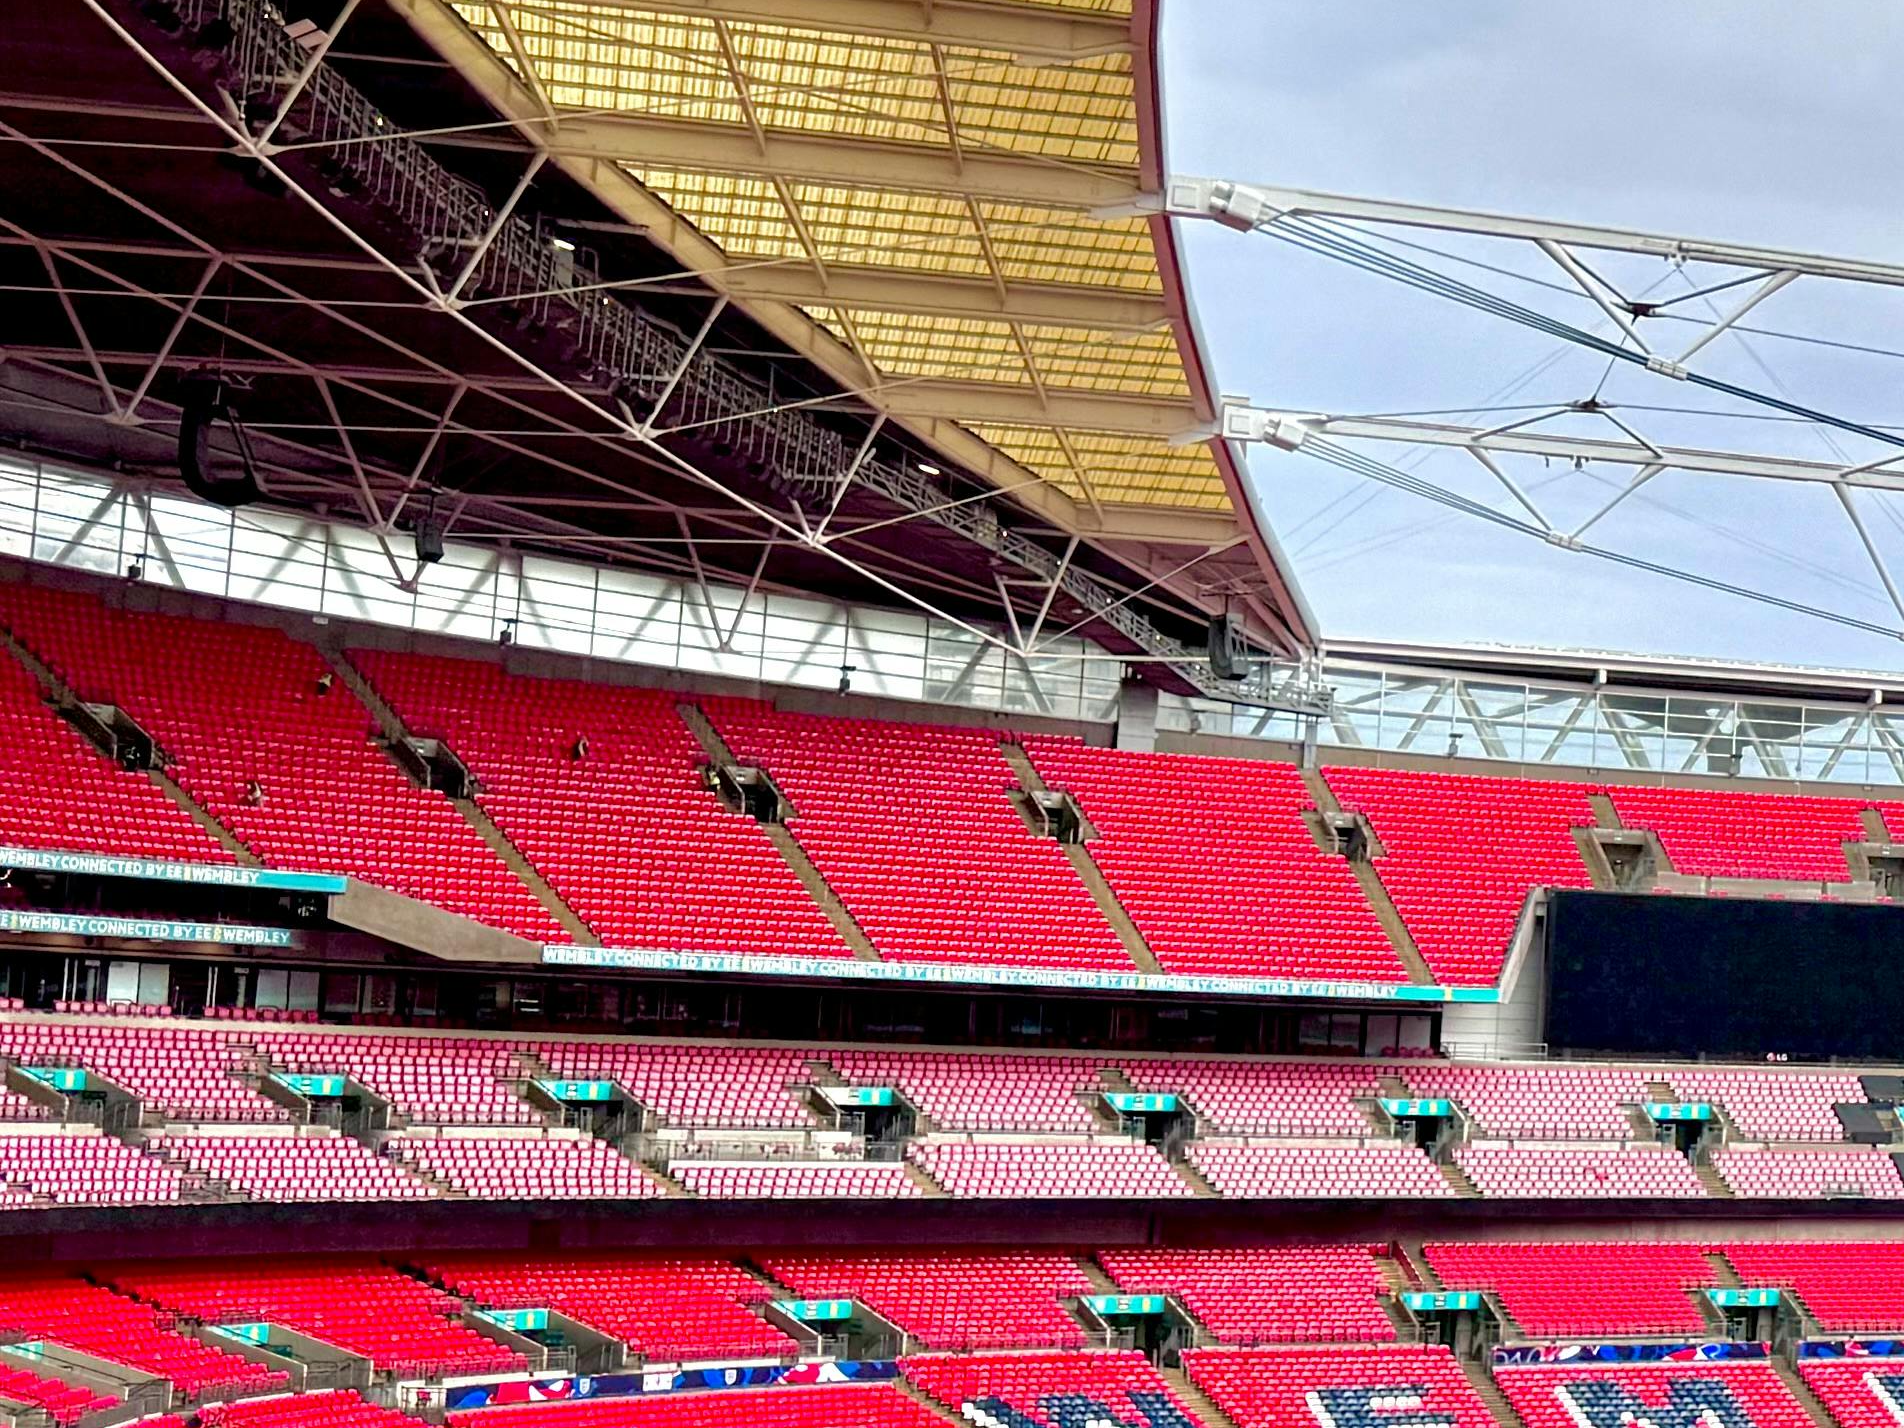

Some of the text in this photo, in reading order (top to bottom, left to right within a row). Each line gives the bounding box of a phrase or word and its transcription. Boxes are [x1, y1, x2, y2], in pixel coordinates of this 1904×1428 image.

[61, 856, 143, 874] CONNECTED
[148, 864, 168, 876] BY
[20, 916, 85, 932] WEMBLEY
[89, 919, 169, 937] CONNECTED
[173, 925, 192, 939] BY
[197, 927, 211, 939] EE
[223, 929, 290, 944] WEMBLEY
